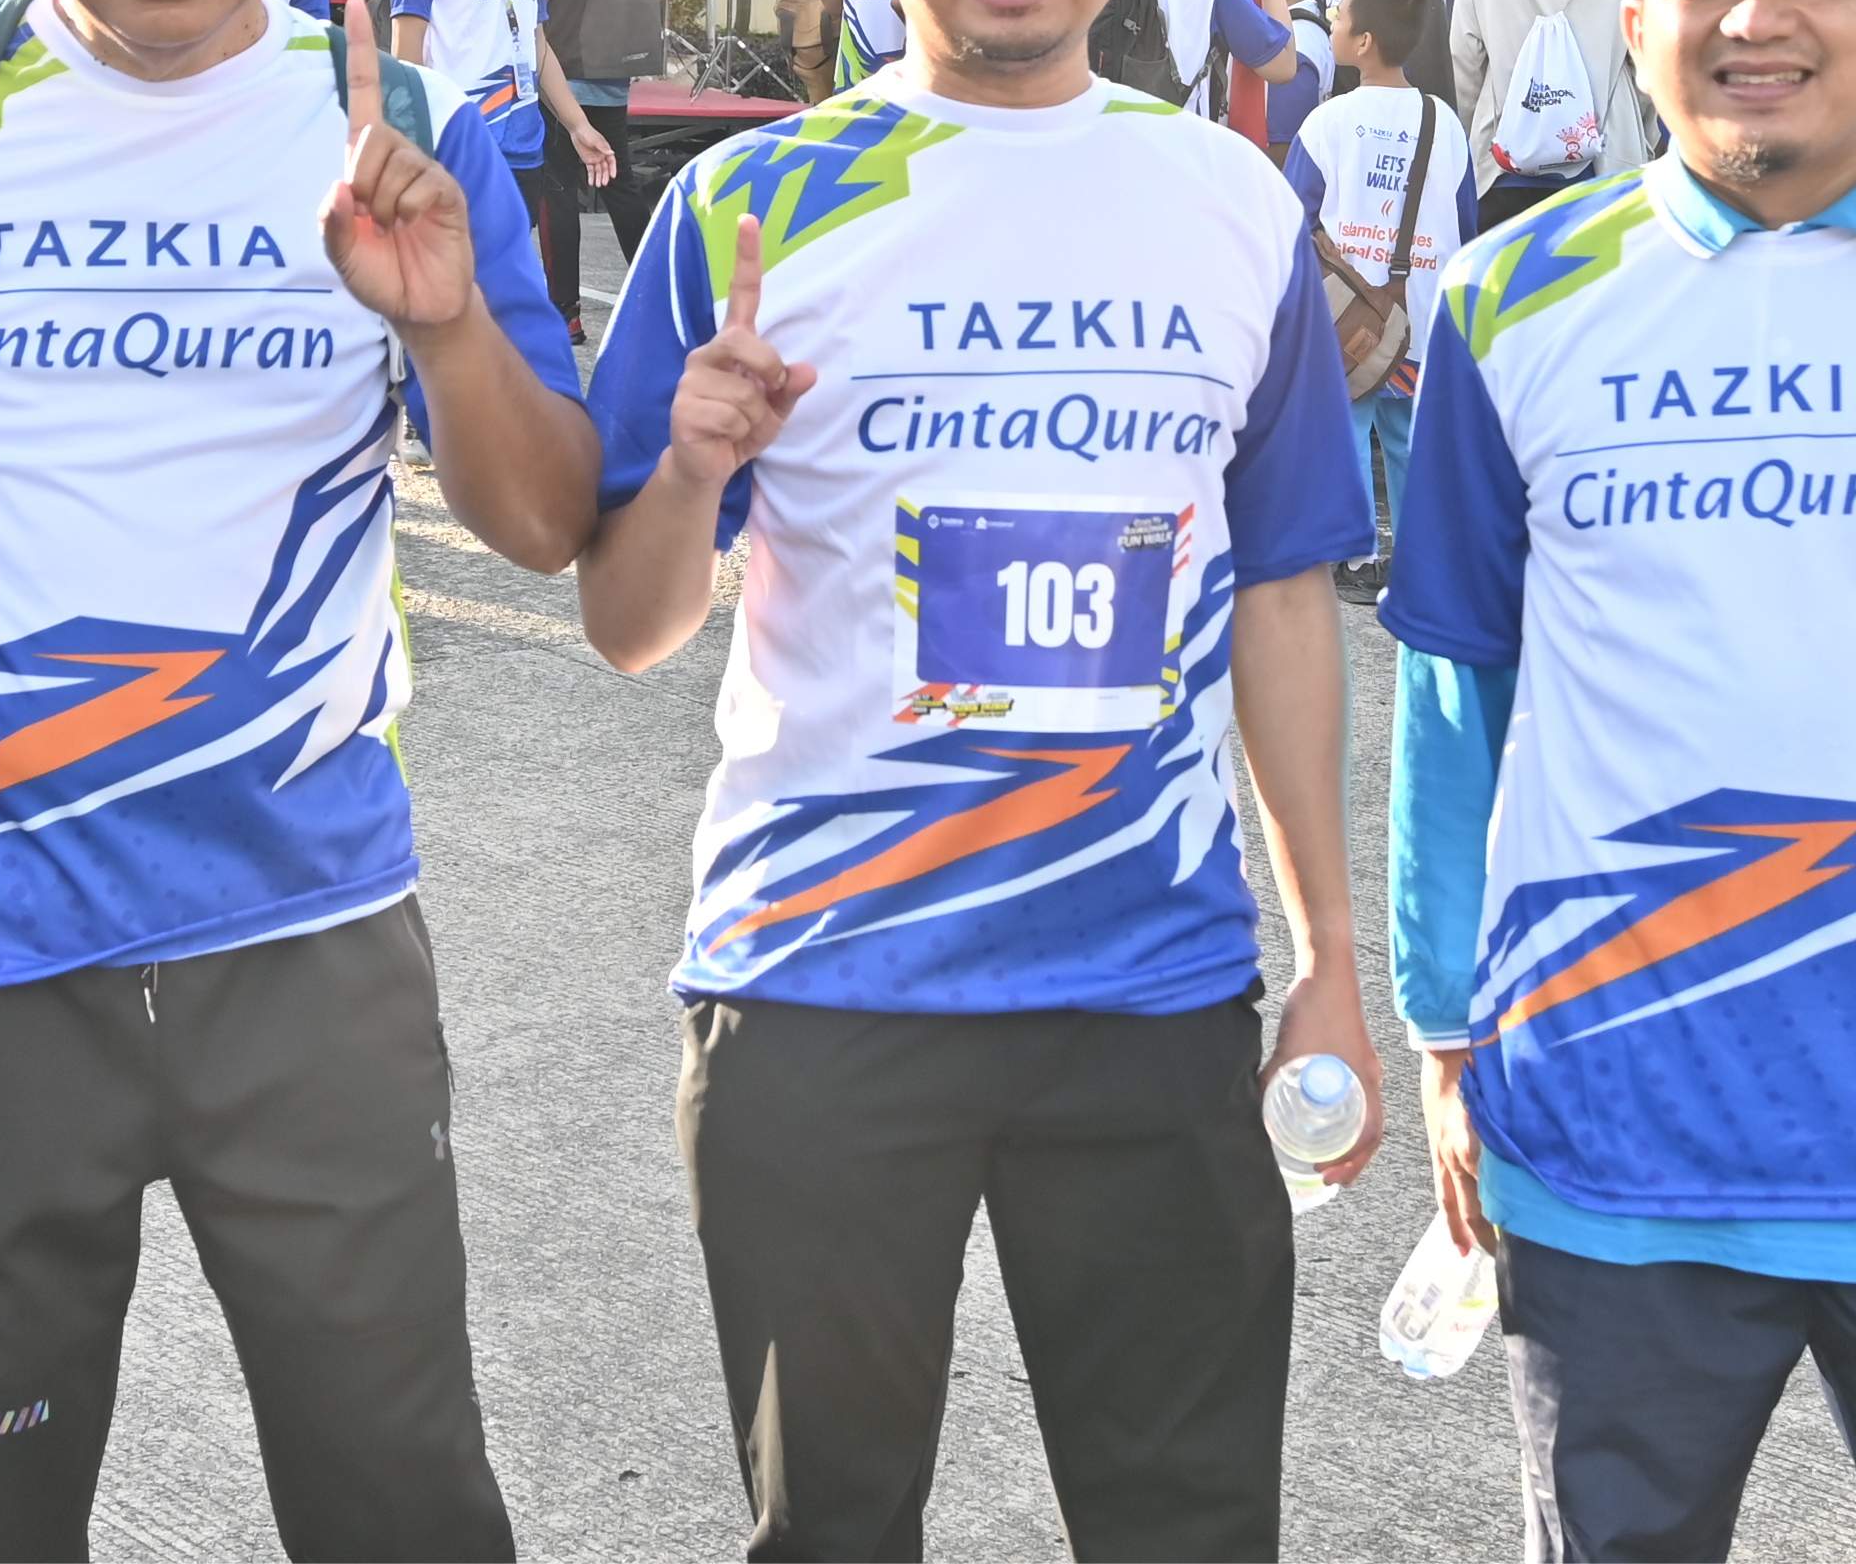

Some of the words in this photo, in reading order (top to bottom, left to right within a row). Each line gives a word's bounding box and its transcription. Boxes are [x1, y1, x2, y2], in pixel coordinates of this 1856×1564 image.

[1366, 171, 1402, 193] WALK
[1338, 221, 1387, 242] Islamic
[907, 299, 1204, 354] TAZKIA
[1117, 534, 1143, 549] FUN
[1143, 531, 1175, 548] WALK
[996, 560, 1116, 649] 103
